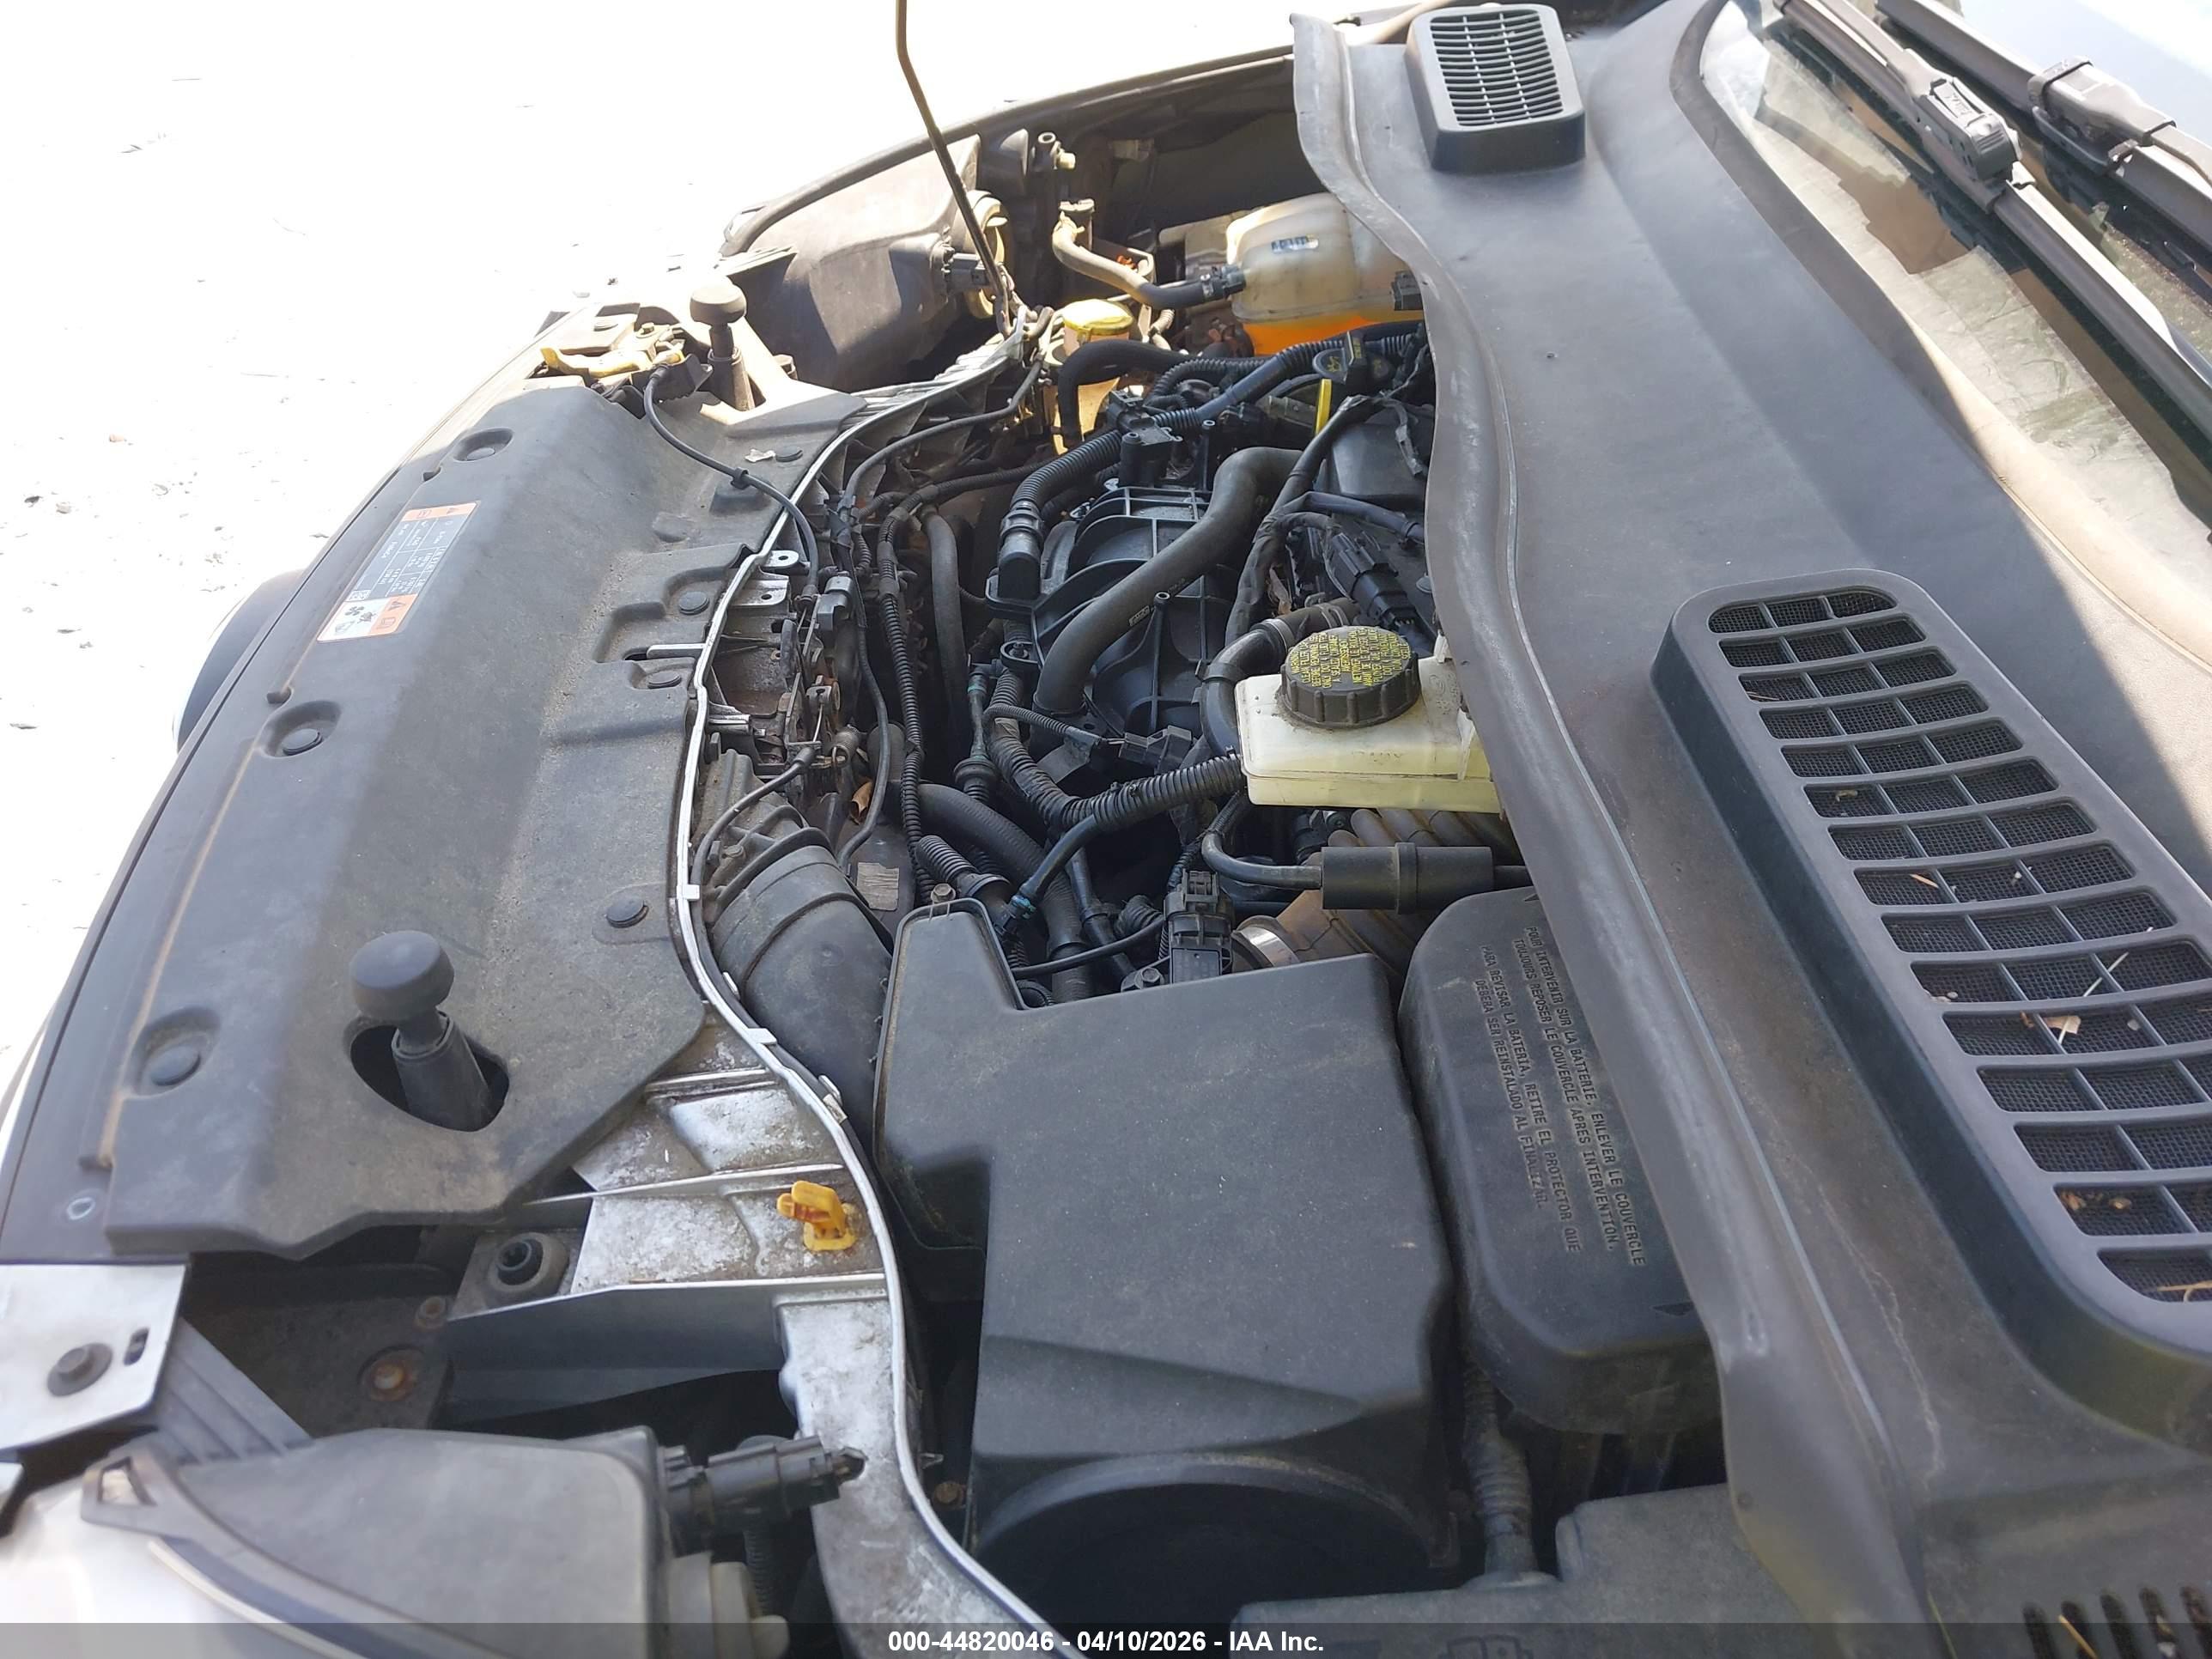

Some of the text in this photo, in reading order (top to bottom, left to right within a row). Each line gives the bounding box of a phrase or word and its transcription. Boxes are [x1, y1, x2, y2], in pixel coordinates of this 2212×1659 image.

[1319, 643, 1329, 655] FLUID
[1300, 652, 1310, 665] FILLER
[1330, 658, 1340, 676] SEALED
[1301, 666, 1311, 684] CLEAN
[1311, 666, 1322, 687] BEFORE
[1321, 663, 1330, 673] DOT
[1351, 658, 1363, 684] NETTOYER
[1382, 665, 1393, 676] DOT
[1322, 675, 1332, 688] ONLY
[1363, 672, 1373, 686] AVANT
[1526, 927, 1542, 946] POUR
[1535, 951, 1563, 1004] INTERVENIR
[1556, 1008, 1572, 1026] SUR
[1565, 1031, 1578, 1043] LA
[1487, 1018, 1501, 1035] SER
[1494, 1040, 1523, 1109] REINSTALADO
[1515, 1116, 1528, 1130] AL
[1481, 945, 1497, 967] PARA
[1490, 969, 1510, 1007] REVISAR
[1504, 1012, 1516, 1024] LA
[1524, 1084, 1547, 1124] RETIRE
[1538, 1130, 1552, 1145] EL
[1546, 1152, 1572, 1220] PROTECTOR
[1565, 1228, 1581, 1251] QUE
[1514, 939, 1619, 1250] TOUJOURS REPOSER LE COUVERCLE APRES INTERVENTION.
[1591, 1113, 1616, 1164] ENLEVER
[1608, 1170, 1623, 1186] LE
[1615, 1193, 1646, 1265] COUVERCLE
